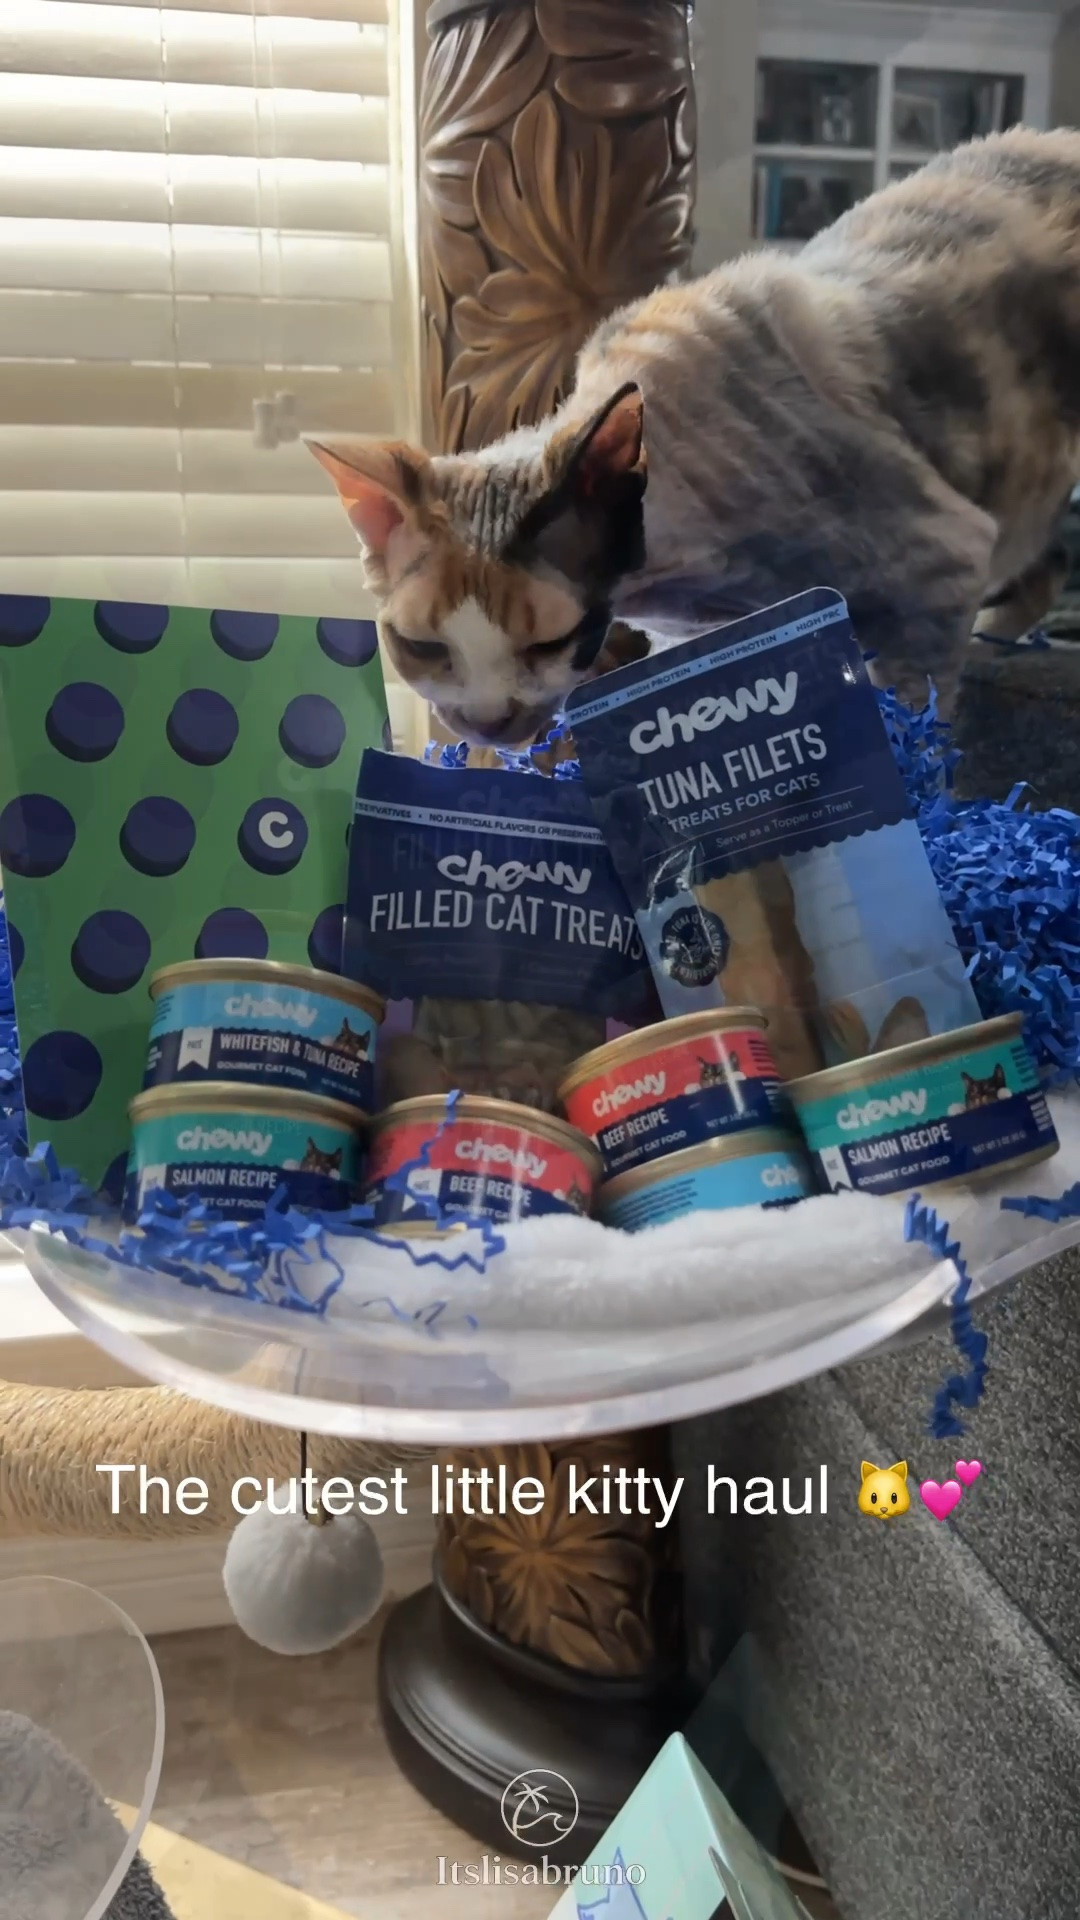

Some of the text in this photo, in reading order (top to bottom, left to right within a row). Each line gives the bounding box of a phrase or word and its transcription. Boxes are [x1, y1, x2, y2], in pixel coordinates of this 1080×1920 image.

[570, 700, 609, 721] PROTEIN
[627, 683, 651, 698] HIGH
[652, 667, 691, 687] PROTEIN
[709, 652, 735, 665] HIGH
[736, 634, 777, 655] PROTEIN
[796, 617, 821, 633] HIGH
[629, 671, 798, 755] chewy
[637, 723, 828, 815] TUNA FILETS
[429, 813, 443, 822] NO
[445, 815, 492, 829] ARTIFICIAL
[495, 821, 536, 833] FLAVORS
[538, 826, 551, 834] OR
[668, 773, 821, 833] TREATS FOR CATS
[715, 832, 747, 848] Serve
[750, 828, 762, 838] as
[771, 812, 809, 830] Topper
[811, 809, 823, 819] or
[824, 800, 853, 815] Treat
[437, 850, 592, 893] chewy
[370, 889, 644, 960] FILLED CAT TREATS
[223, 992, 318, 1028] chewy
[216, 1060, 263, 1071] GOURMET
[264, 1063, 283, 1073] CAT
[220, 1033, 360, 1078] WHITEFISH & TUNA RECIPE
[592, 1070, 667, 1117] chewy
[836, 1087, 927, 1130] chewy
[176, 1125, 272, 1157] chewy
[603, 1108, 669, 1149] BEEF RECIPE
[644, 1139, 660, 1151] CAT
[661, 1130, 687, 1144] FOOD
[848, 1123, 952, 1166] SALMON RECIPE
[172, 1168, 278, 1189] SALMON RECIPE
[455, 1137, 547, 1179] chewy
[857, 1156, 950, 1186] GOURMET CAT FOOD
[216, 1198, 237, 1207] CAT
[486, 1180, 532, 1207] RECPE
